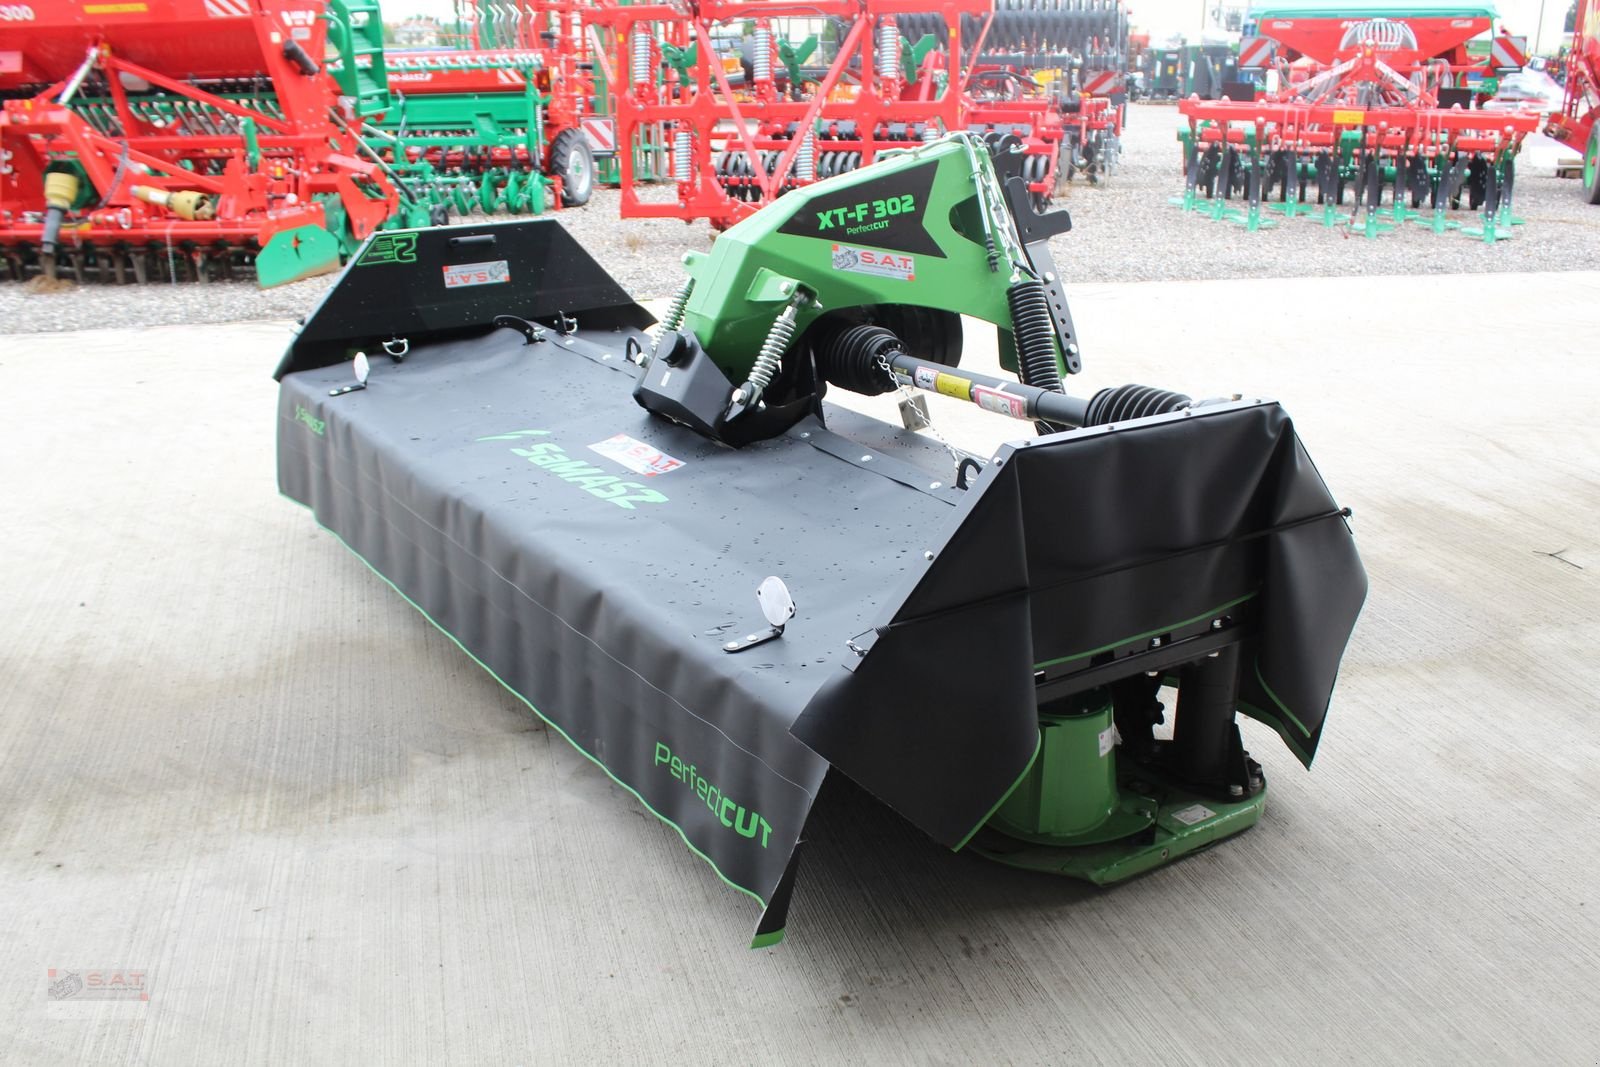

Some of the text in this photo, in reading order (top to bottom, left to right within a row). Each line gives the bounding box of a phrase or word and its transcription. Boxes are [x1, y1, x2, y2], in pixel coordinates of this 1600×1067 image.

[816, 194, 915, 230] XT-F 302
[846, 220, 890, 234] PerfectCUT
[860, 251, 912, 269] S.A.T.
[654, 742, 773, 849] PerfectCUT
